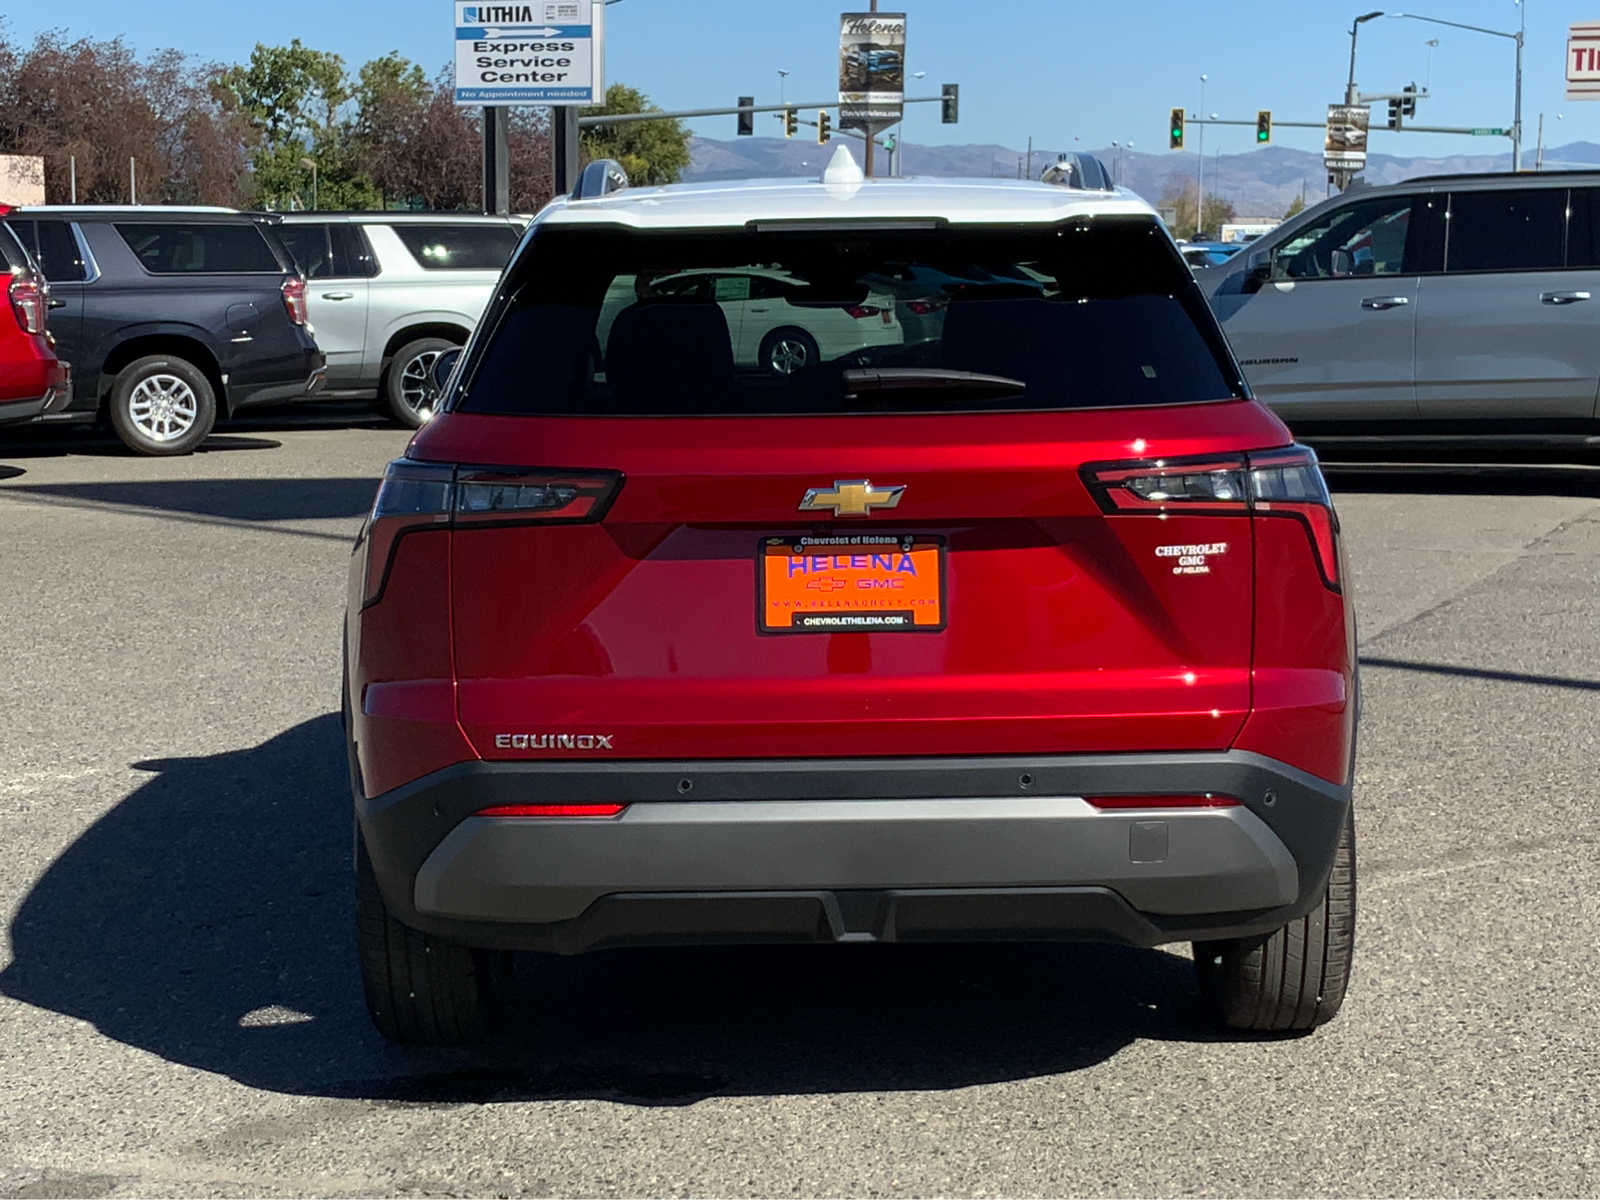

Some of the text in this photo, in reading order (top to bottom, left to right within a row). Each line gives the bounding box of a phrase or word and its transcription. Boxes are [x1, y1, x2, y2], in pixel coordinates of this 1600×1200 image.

[478, 6, 532, 23] LITHIA
[847, 19, 904, 34] Helena
[473, 41, 575, 55] Express
[476, 56, 571, 68] Service
[1572, 48, 1600, 71] TI
[480, 71, 568, 83] Center
[479, 91, 544, 100] Appointment
[800, 536, 898, 545] Chevrolet of Helena
[1154, 542, 1227, 557] CHEVROLET
[786, 552, 918, 578] HELENA
[1178, 555, 1205, 566] GMC
[1183, 566, 1210, 574] HELENA
[856, 578, 905, 589] GMC
[803, 616, 904, 626] CHEVROLETHELENA.COM
[495, 734, 614, 749] EQUINOX
